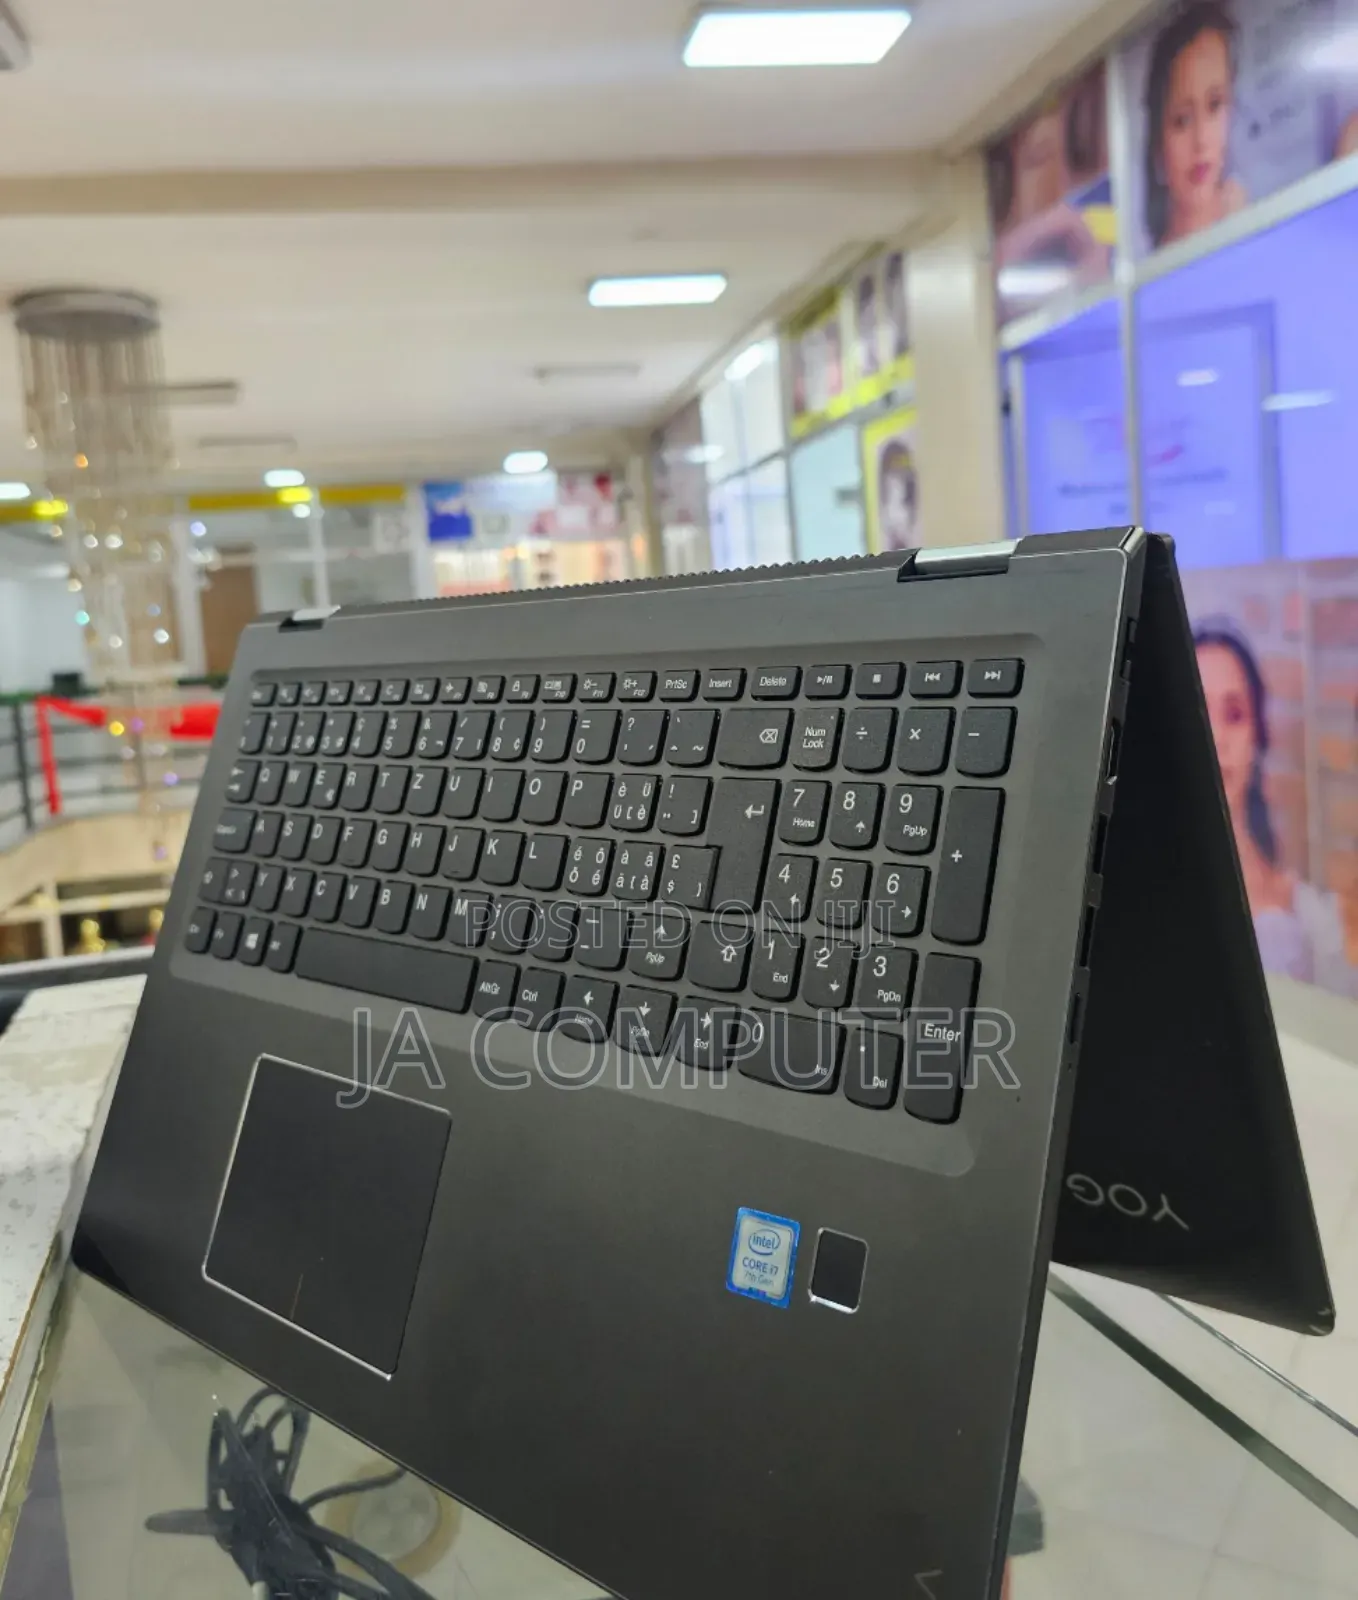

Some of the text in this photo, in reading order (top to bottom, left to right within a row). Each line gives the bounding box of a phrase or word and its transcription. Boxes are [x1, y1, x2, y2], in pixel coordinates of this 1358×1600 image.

[665, 679, 687, 690] PrtSc
[709, 678, 733, 688] Insert
[759, 676, 787, 686] Delete
[389, 717, 398, 730] %
[424, 717, 431, 730] &
[460, 717, 468, 728] /
[540, 717, 546, 731] )
[581, 720, 591, 728] =
[627, 717, 635, 730] ?
[805, 726, 826, 737] Num
[856, 726, 868, 740] ÷
[292, 735, 301, 749] 2
[322, 736, 331, 750] 3
[351, 736, 360, 749] 4
[384, 736, 393, 750] 5
[418, 736, 427, 751] 6
[455, 737, 464, 751] 7
[492, 737, 521, 752] 8 ¢
[534, 738, 543, 753] 9
[576, 738, 586, 754] 0
[803, 738, 824, 748] Lock
[260, 768, 270, 783] Q
[288, 769, 300, 784] W
[316, 770, 326, 785] E
[346, 771, 357, 786] R
[381, 772, 390, 787] T
[412, 773, 424, 789] Z
[450, 775, 460, 791] U
[487, 777, 493, 792] I
[529, 778, 541, 795] O
[571, 780, 583, 796] P
[618, 782, 627, 797] è
[668, 784, 675, 798] !
[793, 788, 805, 808] 7
[843, 790, 856, 810] 8
[899, 793, 912, 814] 9
[638, 804, 646, 820] è
[691, 809, 698, 824] ]
[256, 820, 264, 833] A
[283, 820, 294, 836] S
[792, 817, 815, 828] Home
[312, 823, 323, 839] D
[344, 826, 354, 841] F
[377, 828, 388, 845] G
[903, 824, 928, 837] PgUp
[411, 832, 422, 848] H
[448, 835, 458, 852] J
[487, 838, 499, 855] K
[529, 842, 538, 859] L
[574, 846, 582, 861] é
[621, 849, 629, 864] à
[951, 850, 963, 863] +
[671, 854, 680, 869] £
[258, 872, 268, 886] Y
[592, 869, 600, 885] é
[778, 864, 791, 883] 4
[830, 868, 843, 888] 5
[284, 876, 296, 891] X
[316, 880, 326, 896] C
[667, 880, 675, 894] $
[886, 873, 900, 894] 6
[349, 884, 358, 900] V
[380, 889, 391, 905] B
[416, 893, 428, 910] N
[455, 898, 468, 916] M
[768, 939, 775, 960] 1
[645, 952, 666, 965] PgUp
[816, 947, 830, 968] 2
[873, 956, 886, 977] 3
[773, 972, 788, 984] End
[479, 981, 500, 995] AltGr
[522, 989, 538, 1002] Ctrl
[877, 989, 901, 1002] PgDn
[752, 1022, 764, 1043] 0
[924, 1022, 961, 1042] Enter
[694, 1038, 709, 1050] End
[815, 1063, 829, 1076] Ins
[872, 1076, 888, 1089] Del
[753, 1232, 775, 1249] intel
[743, 1256, 779, 1275] CORE i7
[744, 1270, 774, 1286] 7th Gen
